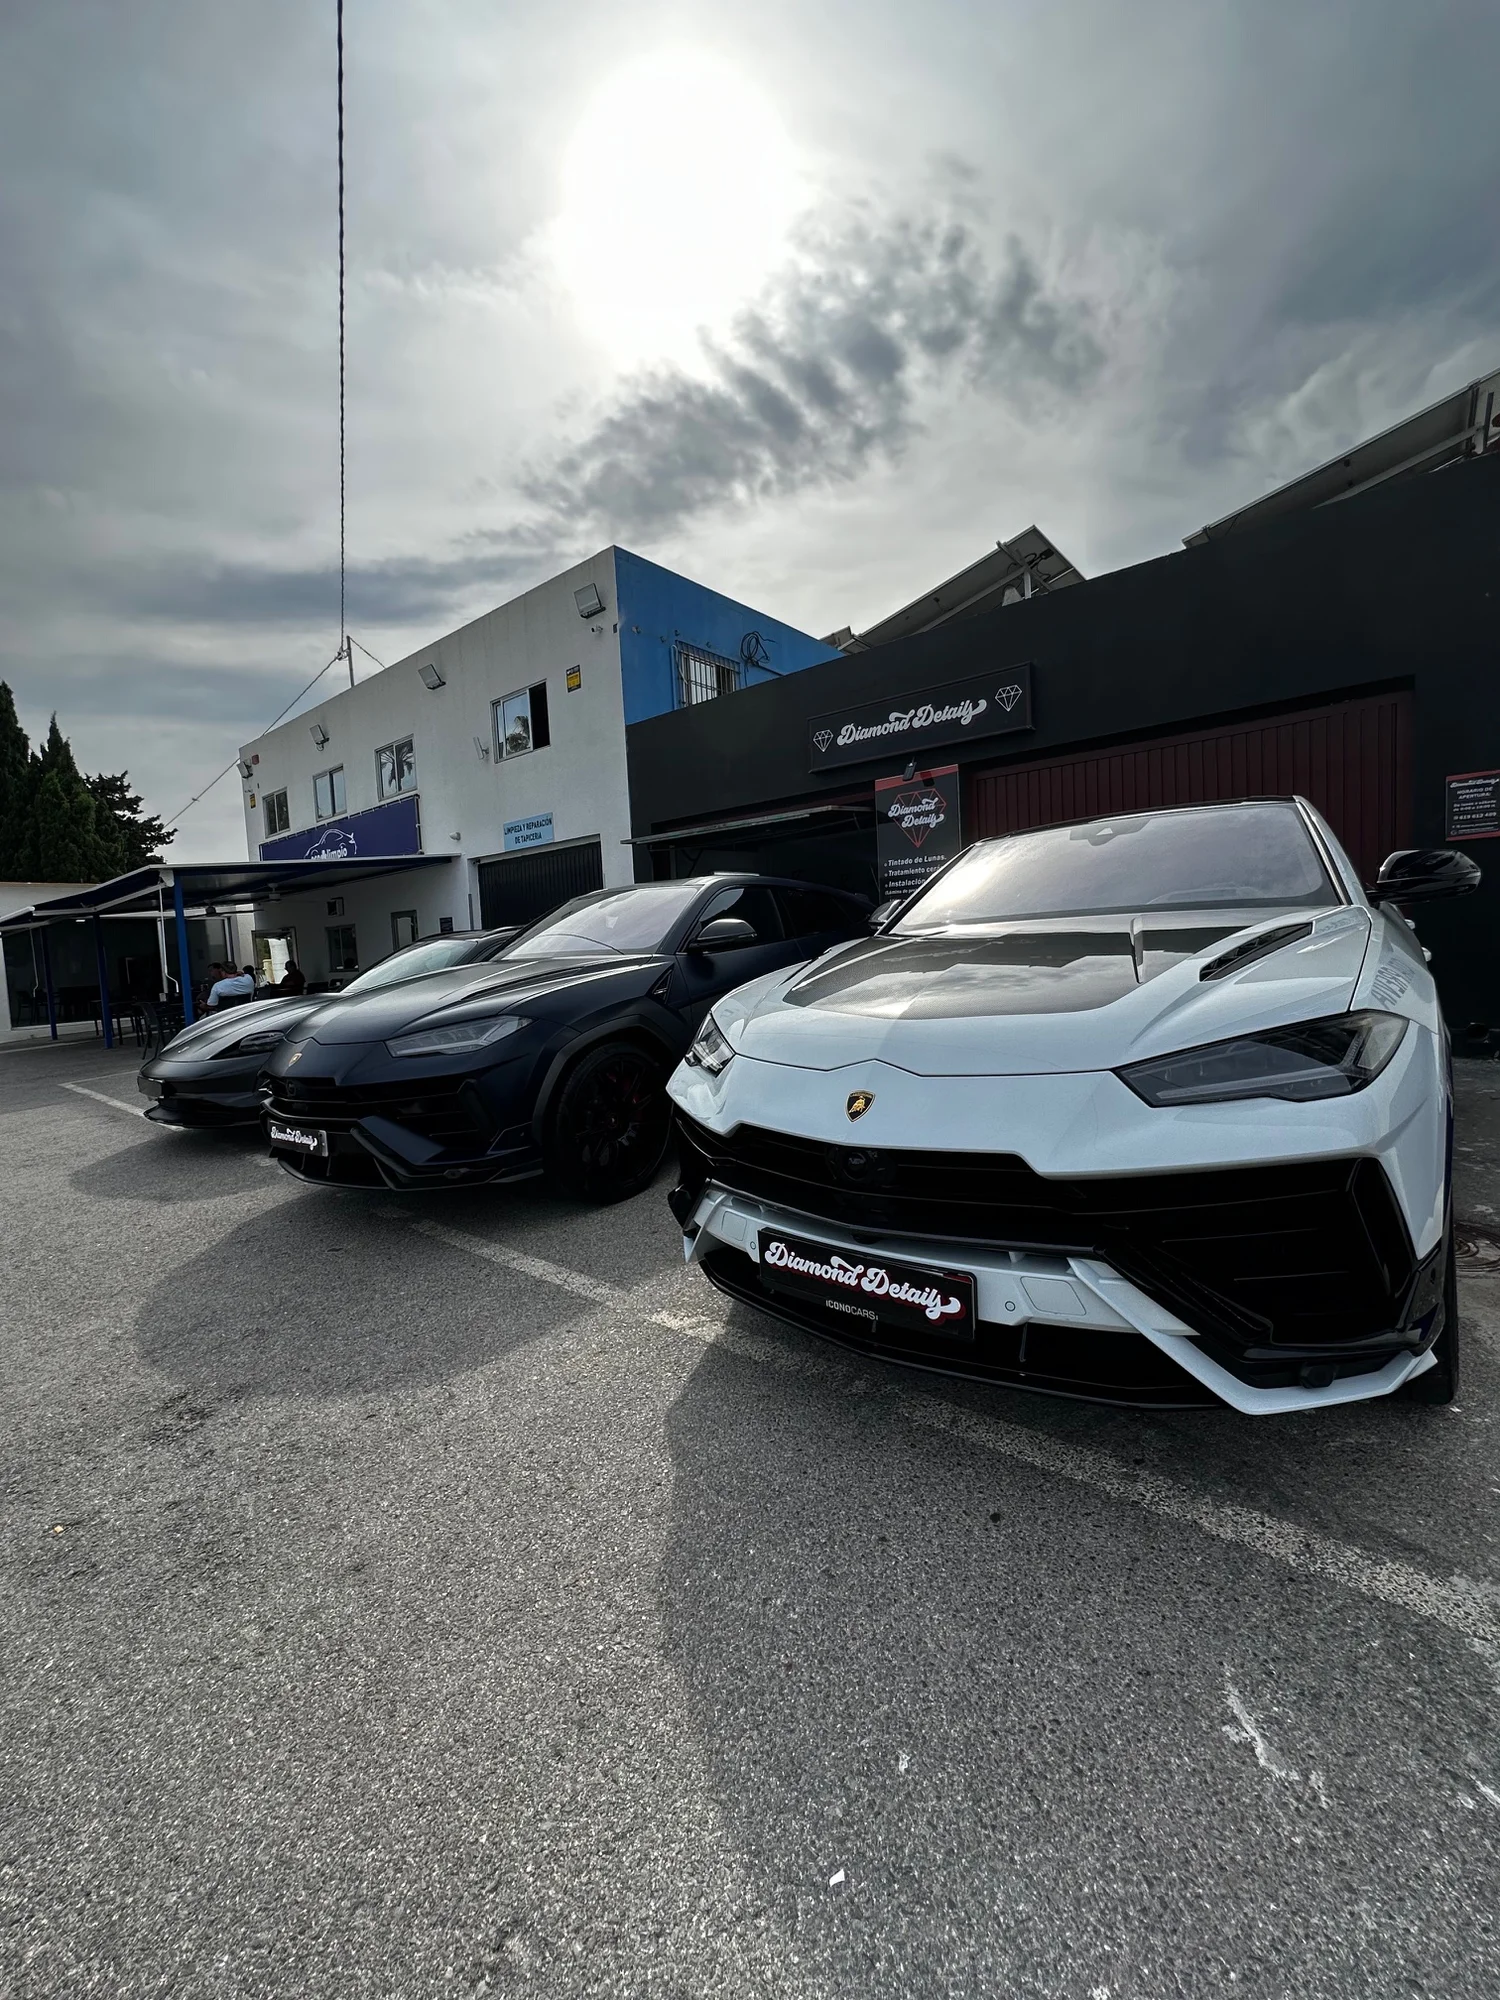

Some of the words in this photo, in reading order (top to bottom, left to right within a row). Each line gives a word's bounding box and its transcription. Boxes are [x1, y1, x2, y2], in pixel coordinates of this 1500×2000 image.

[836, 709, 916, 746] Diamond
[911, 699, 988, 729] Details
[888, 797, 939, 818] Diamond
[901, 813, 945, 829] Details
[504, 825, 522, 835] LIMPIEZA
[514, 836, 521, 844] DE
[888, 858, 913, 867] Tintado
[888, 867, 925, 877] Tratamiento
[270, 1126, 295, 1142] Diamond
[295, 1130, 318, 1150] Details
[764, 1241, 865, 1287] Diamond
[860, 1267, 961, 1320] Details
